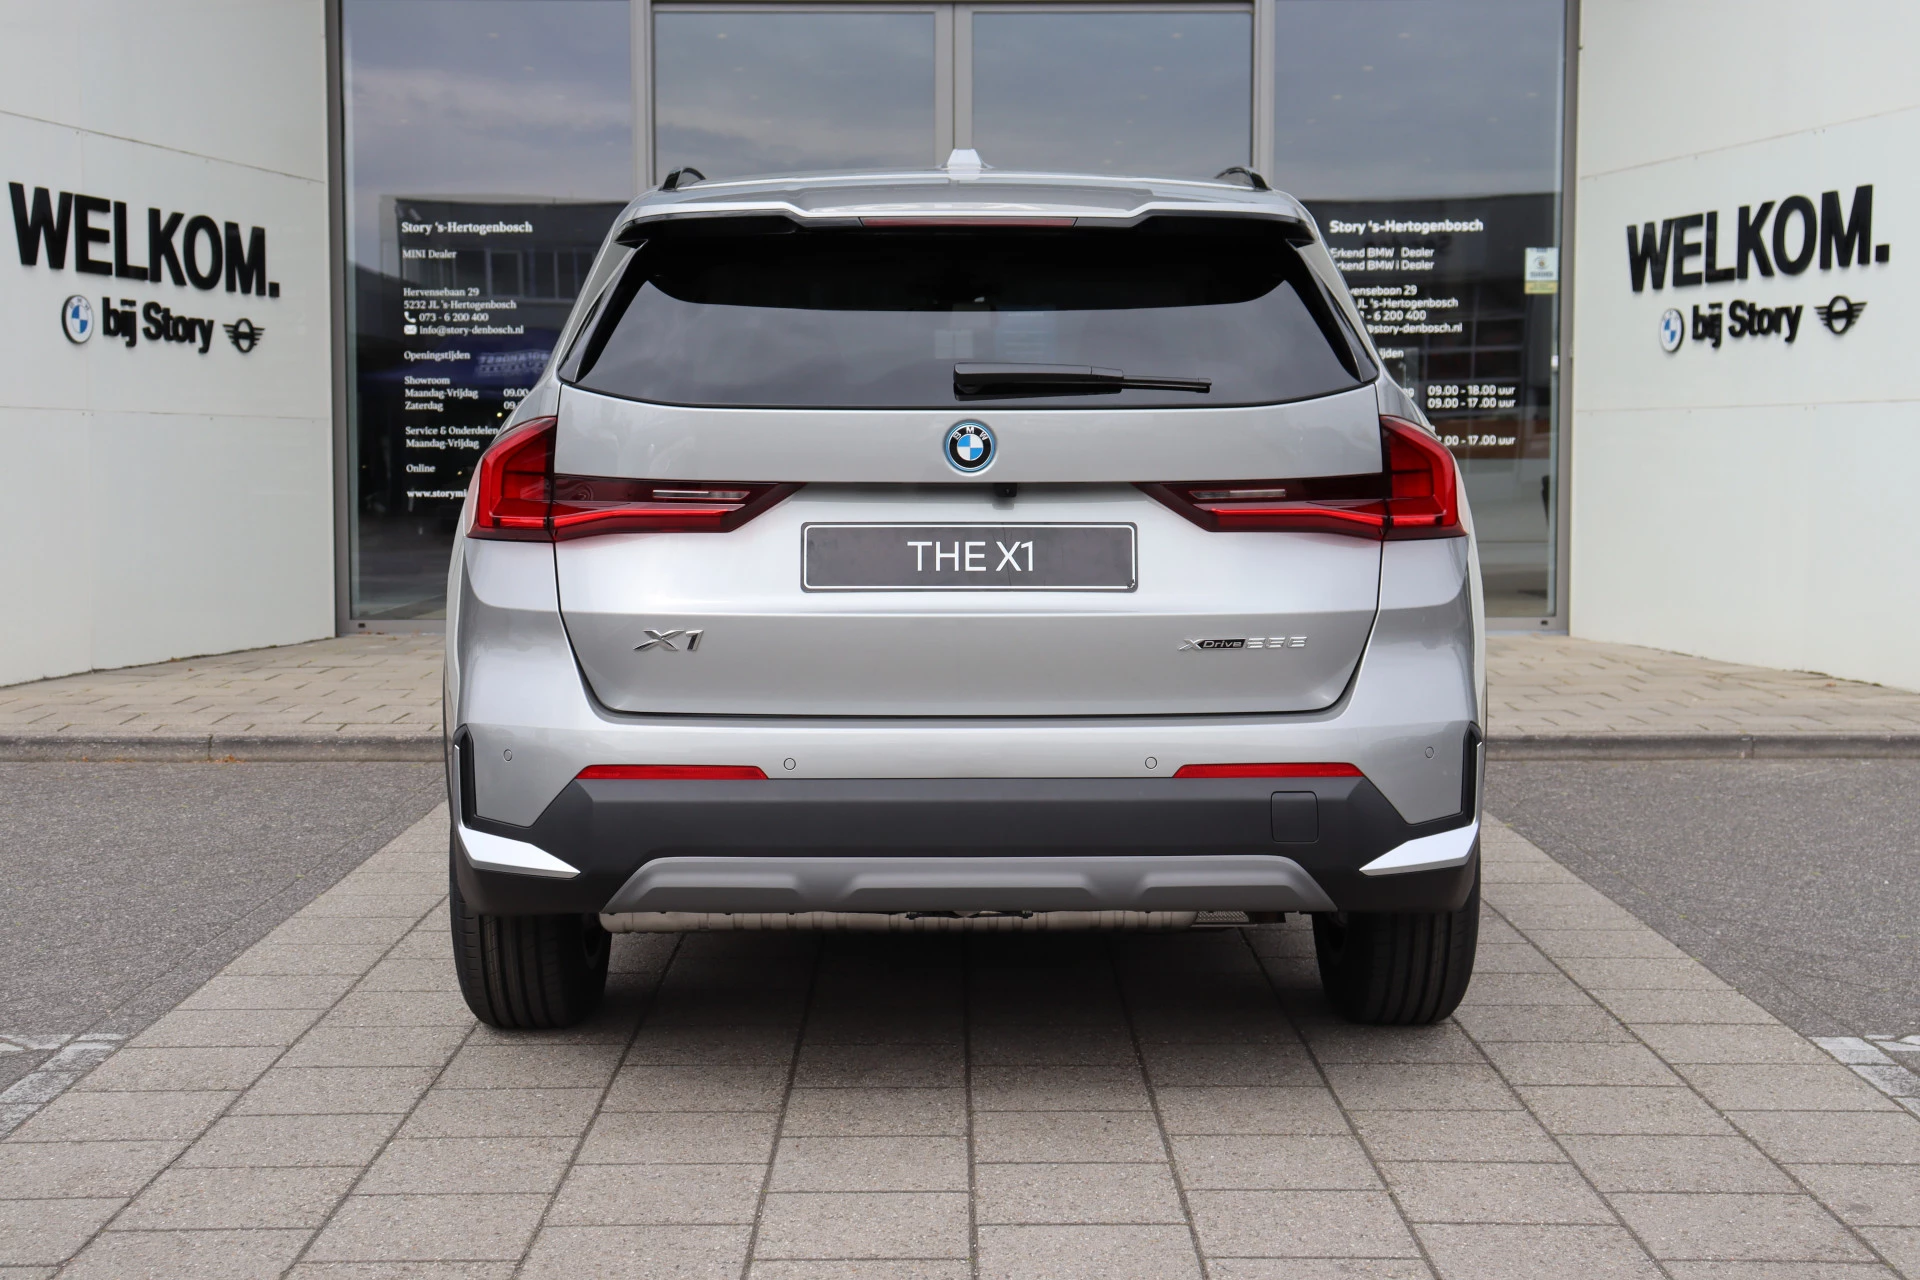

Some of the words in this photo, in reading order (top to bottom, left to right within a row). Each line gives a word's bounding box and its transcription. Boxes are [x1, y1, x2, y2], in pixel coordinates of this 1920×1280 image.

[401, 222, 432, 235] Story
[1329, 220, 1366, 235] Story
[8, 181, 280, 298] WELKOM.
[1626, 183, 1890, 293] WELKOM.
[402, 249, 426, 259] MINI
[428, 249, 457, 259] Dealer
[1367, 247, 1395, 258] BMW
[1401, 246, 1435, 258] Dealer
[1337, 260, 1365, 271] rkend
[1367, 260, 1395, 271] BMW
[1401, 260, 1435, 271] Dealer
[403, 287, 465, 297] Hervensebaan
[467, 287, 480, 297] 29
[1403, 284, 1418, 296] 29
[403, 300, 426, 310] 5232
[428, 300, 440, 310] JL
[418, 312, 437, 322] 073
[444, 312, 451, 322] 6
[453, 312, 470, 322] 200
[471, 312, 489, 322] 400
[1373, 310, 1381, 321] 6
[1382, 310, 1404, 321] 200
[1405, 309, 1427, 321] 400
[102, 296, 137, 348] bij
[142, 301, 214, 354] Story
[1692, 301, 1723, 348] bij
[1728, 299, 1804, 344] Story
[419, 325, 524, 336] info@story-denbosch.nl
[404, 351, 471, 362] Openingstijden
[404, 376, 450, 384] Showroom
[405, 388, 479, 399] Maandag-Vrijdag
[1427, 385, 1459, 396] 09.00
[1467, 384, 1497, 396] 18.00
[1498, 386, 1516, 396] uur
[405, 401, 444, 412] Zaterdag
[1427, 397, 1459, 409] 09.00
[1498, 399, 1516, 408] uur
[405, 426, 438, 435] Service
[440, 427, 447, 435] &
[448, 426, 499, 435] Onderdelen
[406, 439, 480, 450] Maandag-Vrijdag
[1498, 437, 1516, 446] uur
[406, 464, 436, 473] Online
[907, 541, 987, 571] THE
[995, 541, 1033, 571] X1
[632, 629, 704, 651] X1
